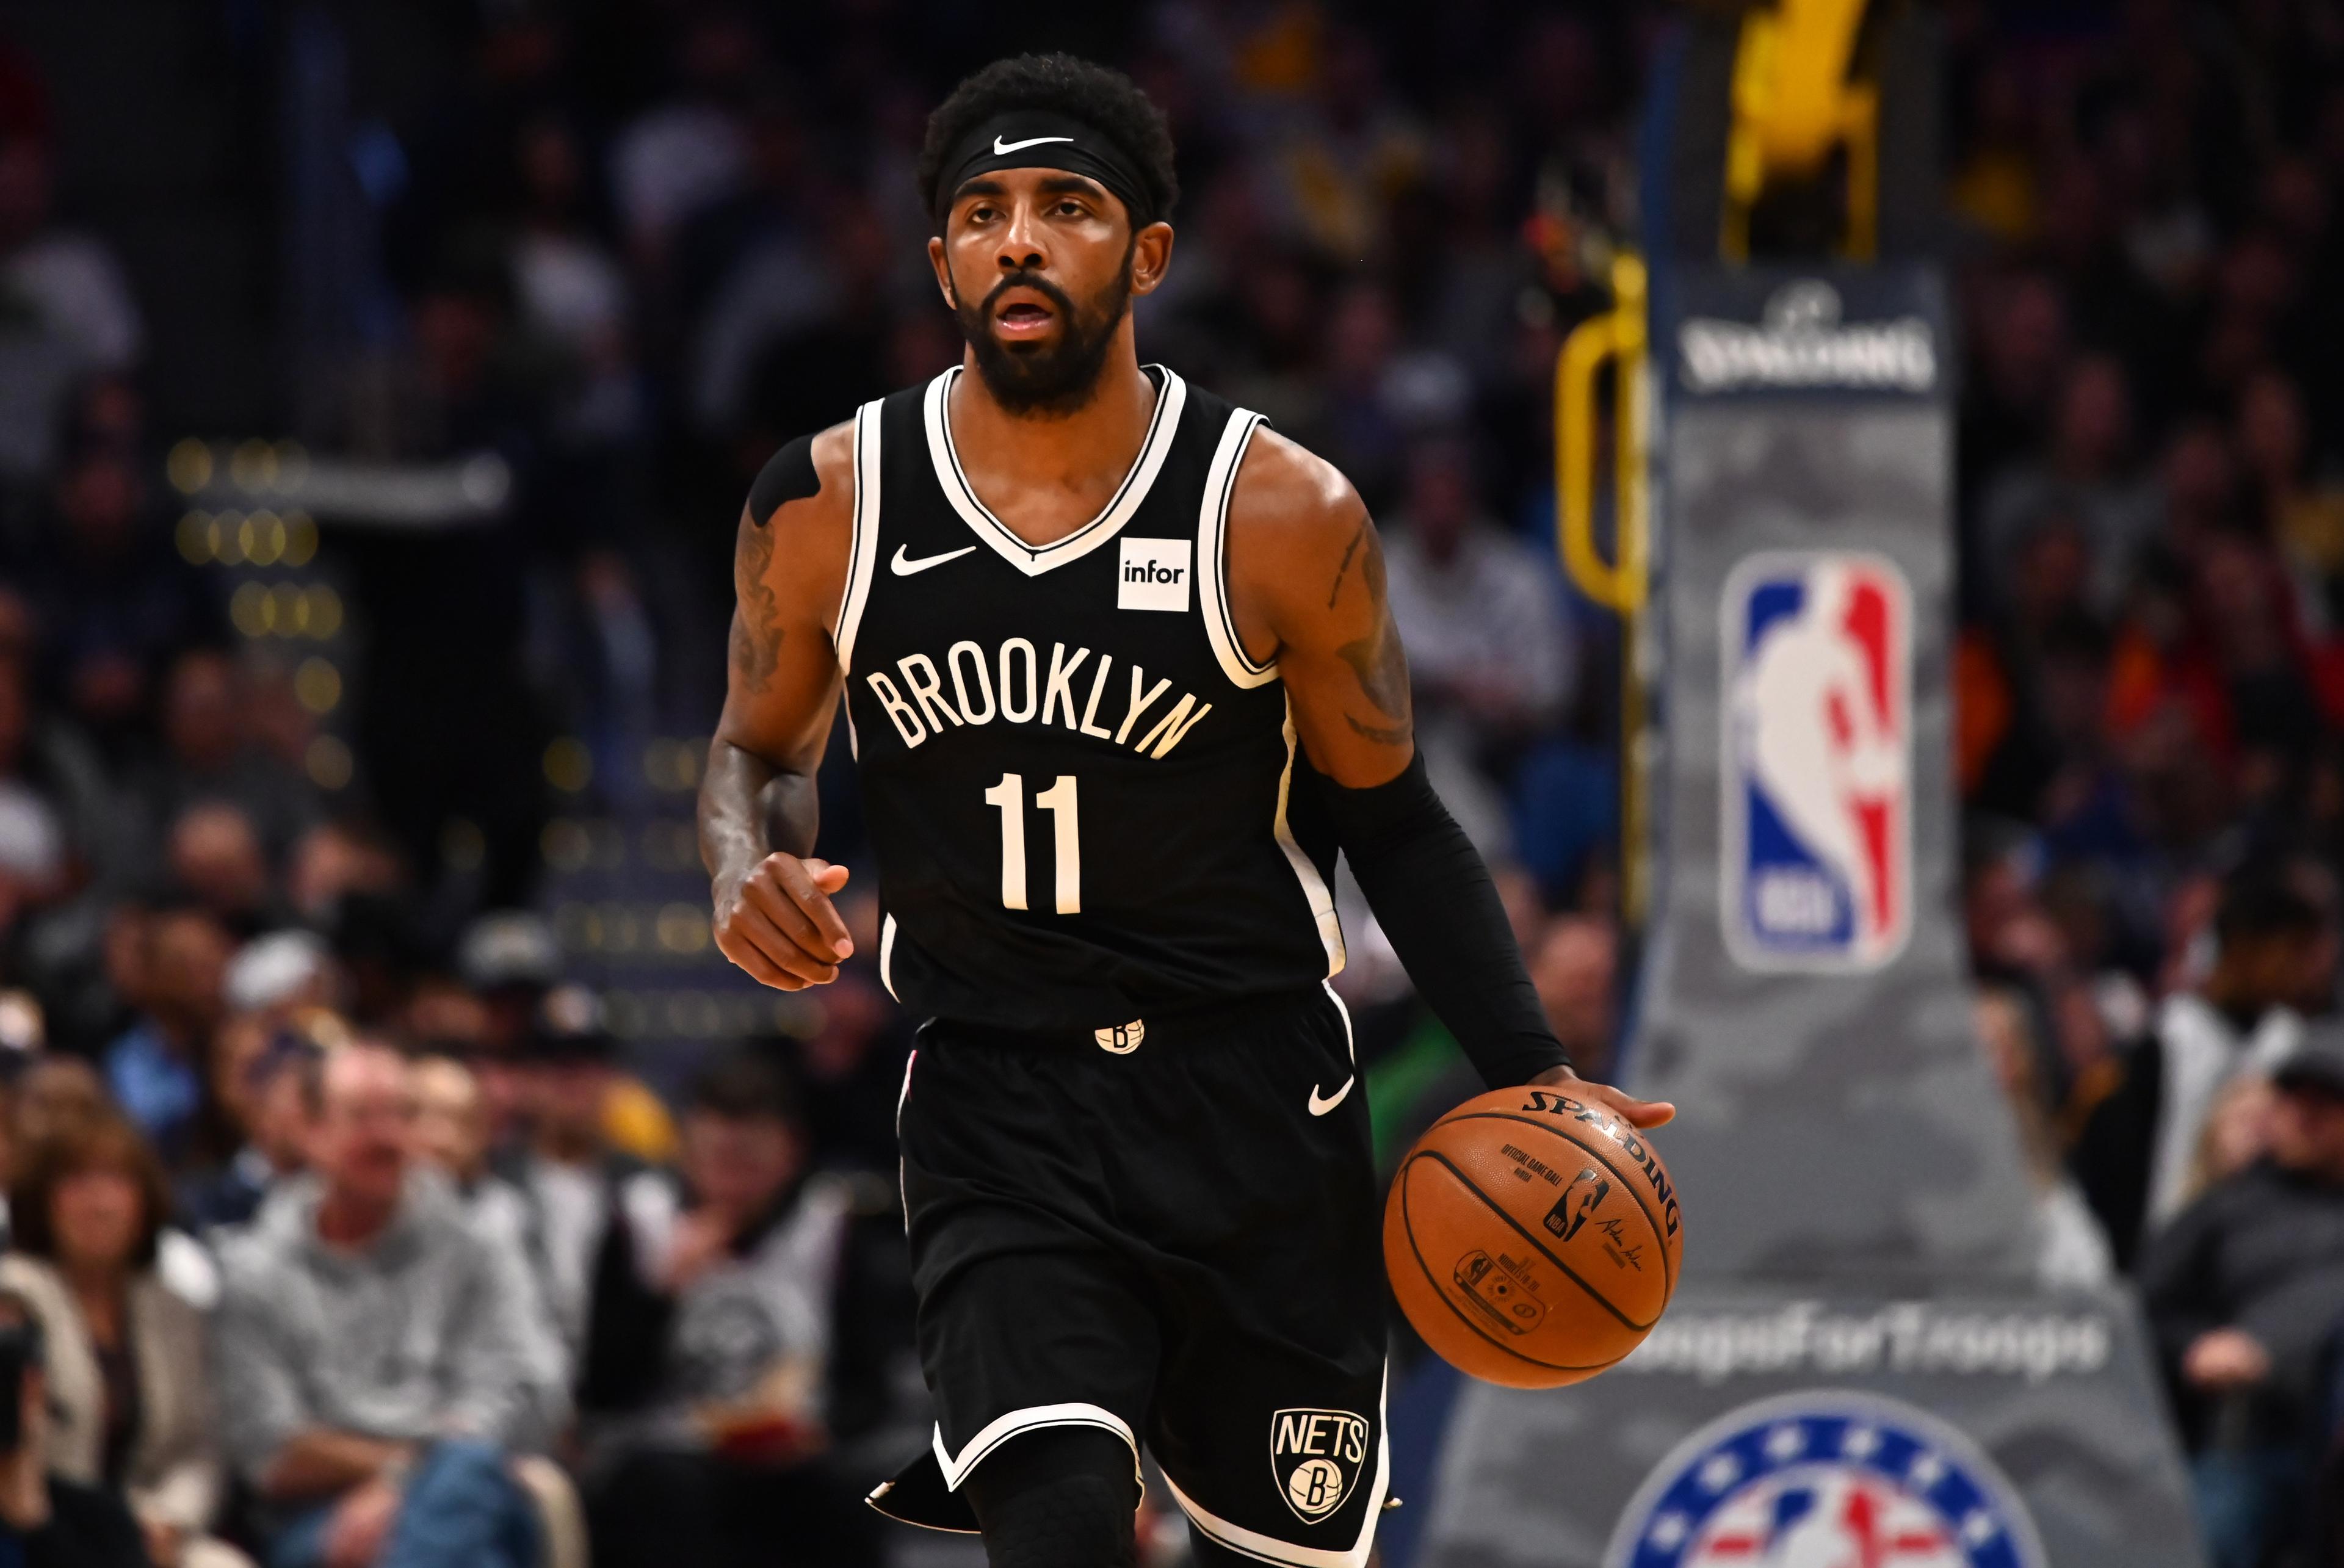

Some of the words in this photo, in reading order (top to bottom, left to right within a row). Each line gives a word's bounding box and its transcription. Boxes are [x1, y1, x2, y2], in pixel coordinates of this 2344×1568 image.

[1124, 560, 1184, 584] infor
[866, 637, 1212, 760] BROOKLYN
[985, 773, 1080, 914] 11
[1501, 1144, 1530, 1166] OFFICIAL
[1527, 1158, 1549, 1177] GAME
[1544, 1169, 1563, 1187] BALL
[1522, 1091, 1678, 1238] SPALDING
[1546, 1213, 1566, 1234] NBA
[1276, 1414, 1364, 1463] NETS
[1306, 1467, 1328, 1506] B
